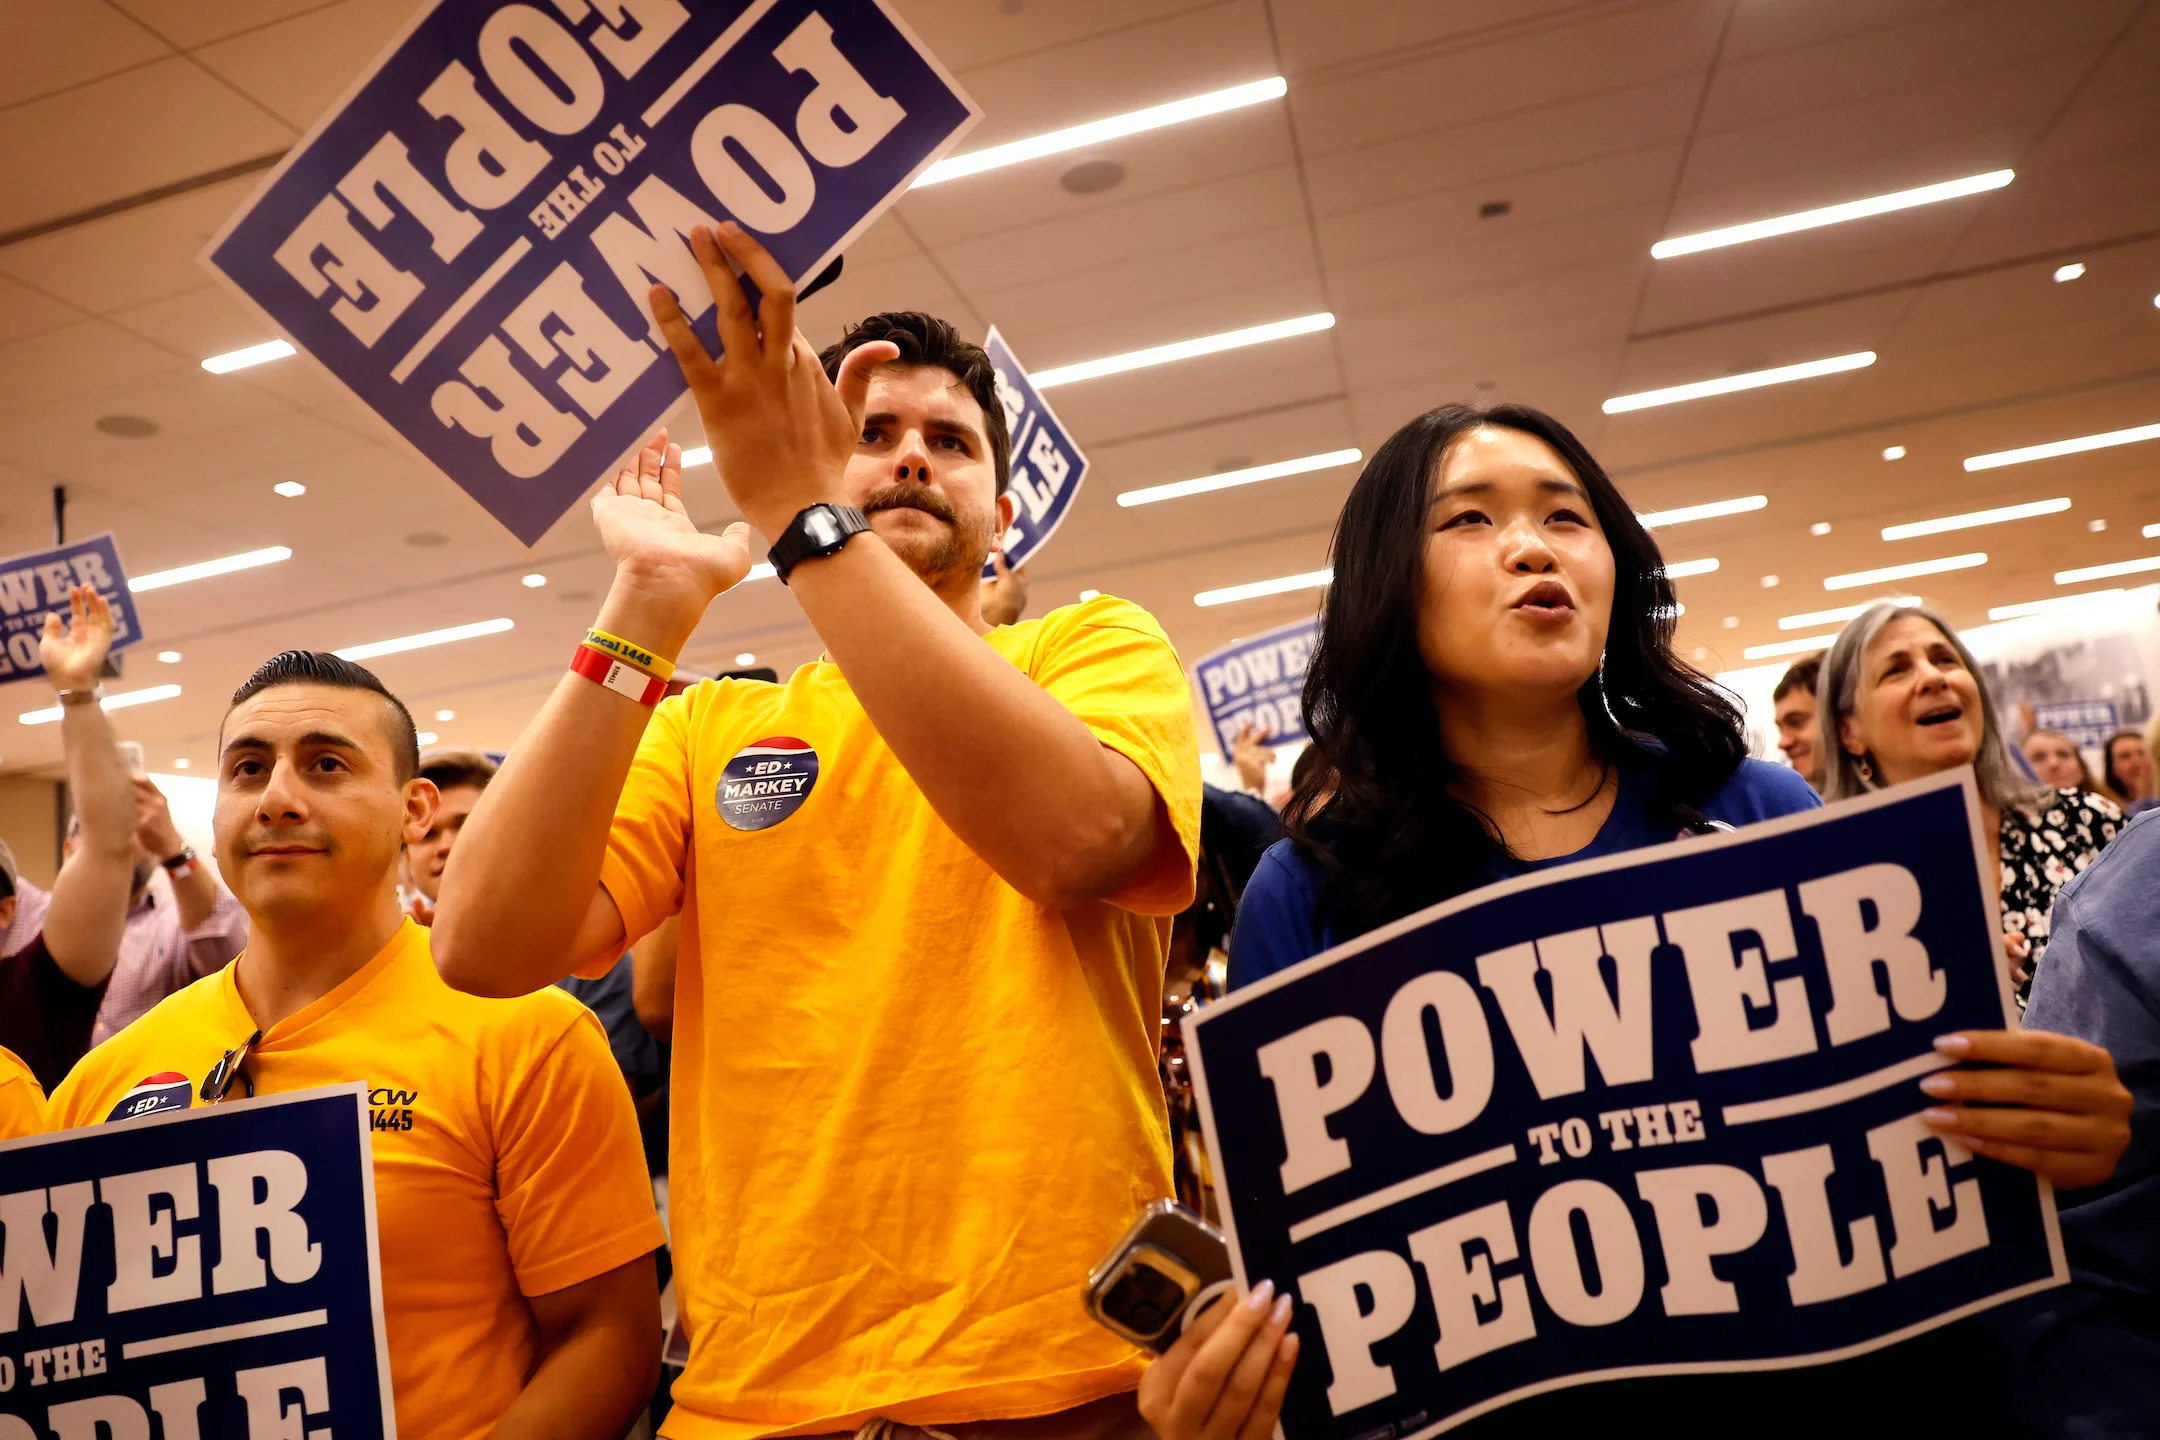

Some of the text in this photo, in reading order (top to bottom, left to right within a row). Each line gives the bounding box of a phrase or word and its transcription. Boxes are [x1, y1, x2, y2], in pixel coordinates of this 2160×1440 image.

[528, 122, 647, 240] TO THE
[431, 10, 908, 478] POWER
[589, 631, 620, 652] Local
[621, 645, 652, 667] 1445
[1203, 632, 1320, 706] POWE
[724, 777, 808, 799] MARKEY
[754, 760, 782, 775] ED
[734, 800, 783, 815] SENATE
[1257, 862, 1948, 1195] POWER
[133, 1096, 159, 1114] ED
[368, 1088, 418, 1105] CW
[369, 1109, 413, 1132] 1445
[1527, 1100, 1706, 1166] TO THE
[1298, 1108, 1991, 1416] PEOPLE
[24, 1338, 107, 1387] THE
